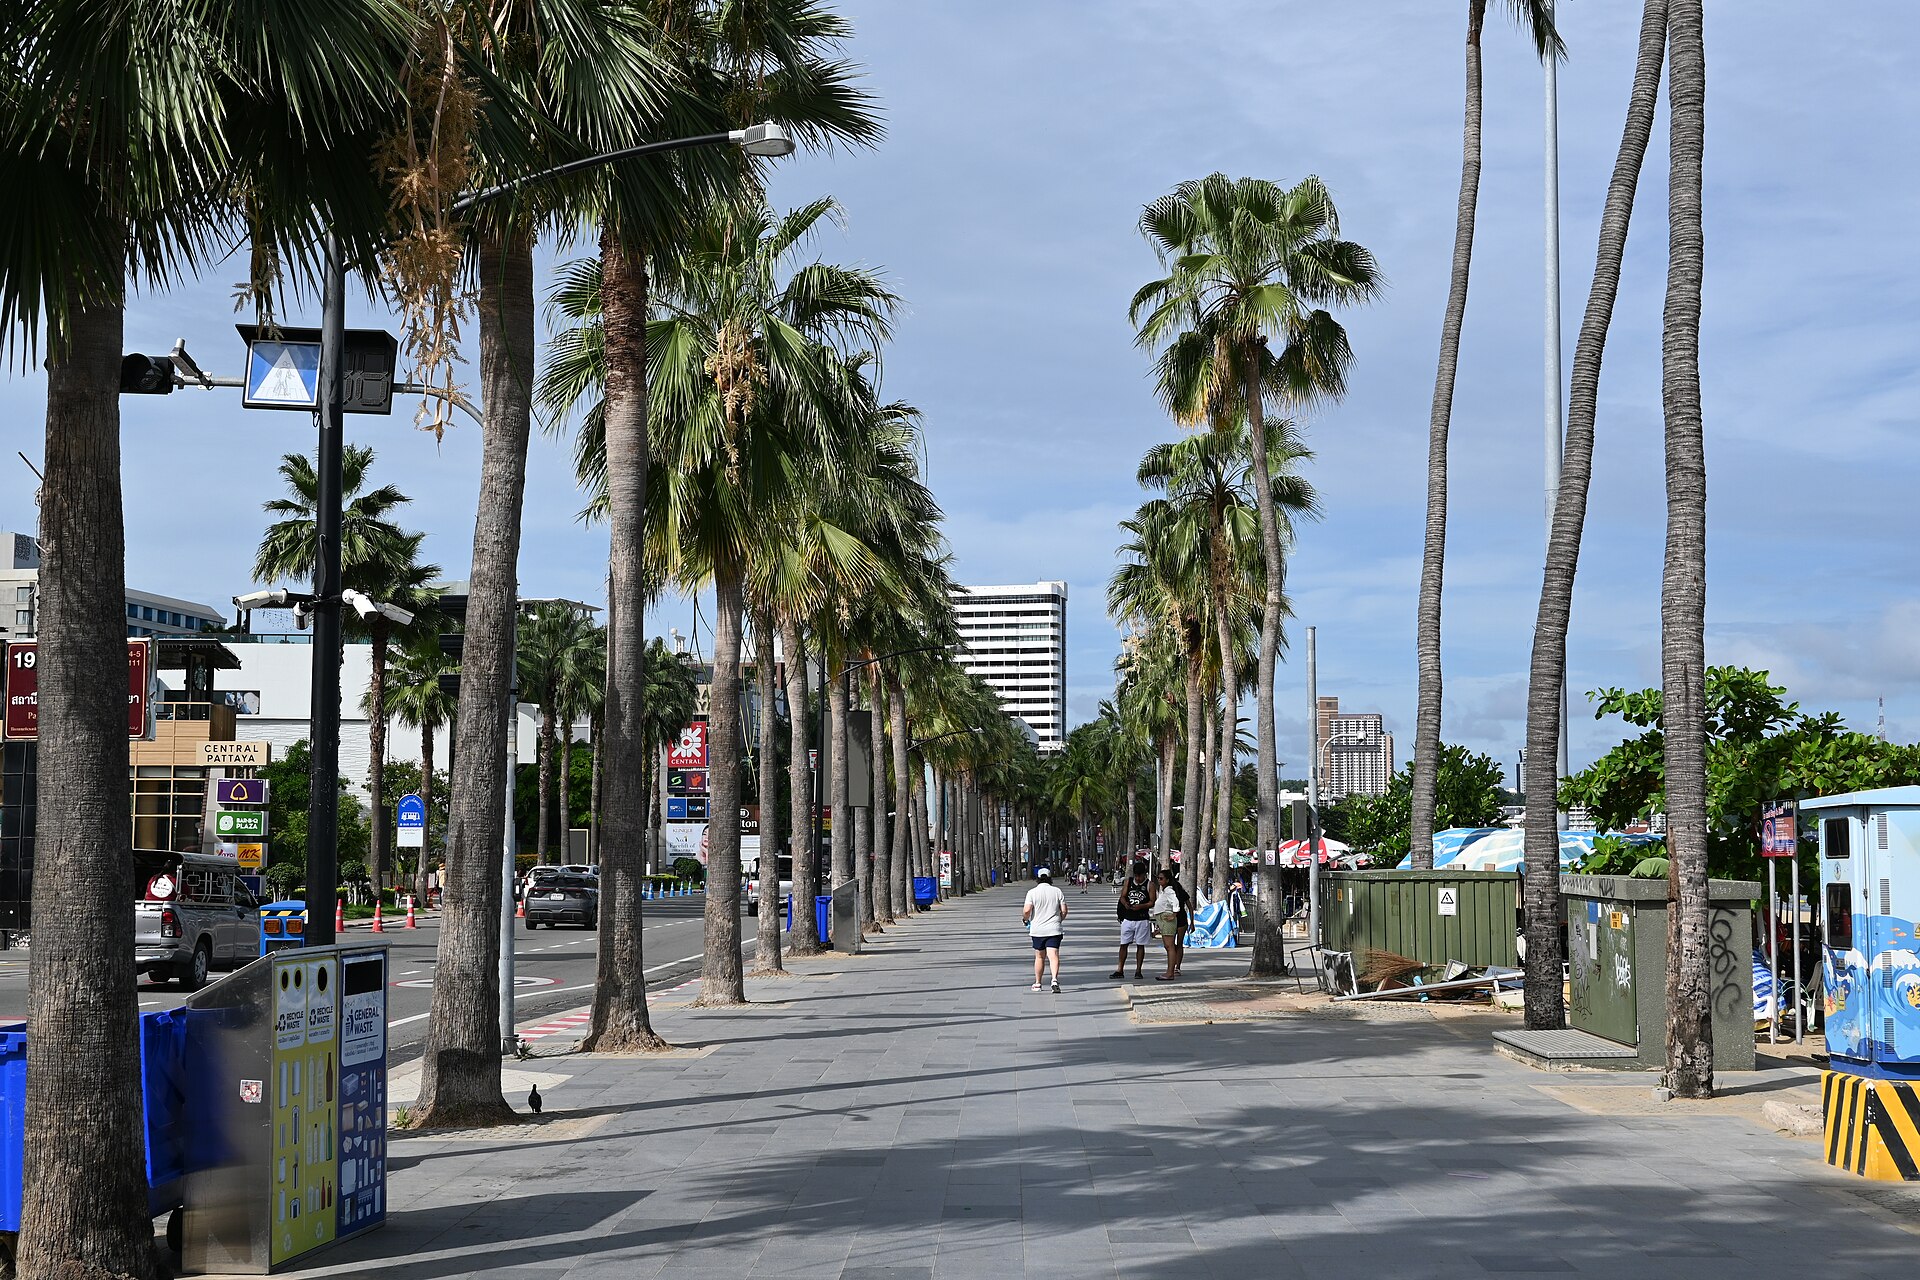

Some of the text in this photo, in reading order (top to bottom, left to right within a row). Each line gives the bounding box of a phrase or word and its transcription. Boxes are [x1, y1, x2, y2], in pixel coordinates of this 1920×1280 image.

[204, 744, 259, 753] CENTRAL
[207, 754, 256, 763] PATTAYA
[740, 819, 758, 828] ton
[238, 848, 261, 859] MK
[316, 1005, 333, 1015] RECYCLE
[354, 1006, 380, 1021] GENERAL
[286, 1011, 304, 1021] RECYCLE
[316, 1014, 330, 1024] WASTE
[286, 1020, 300, 1030] WASTE
[354, 1020, 373, 1035] WASTE
